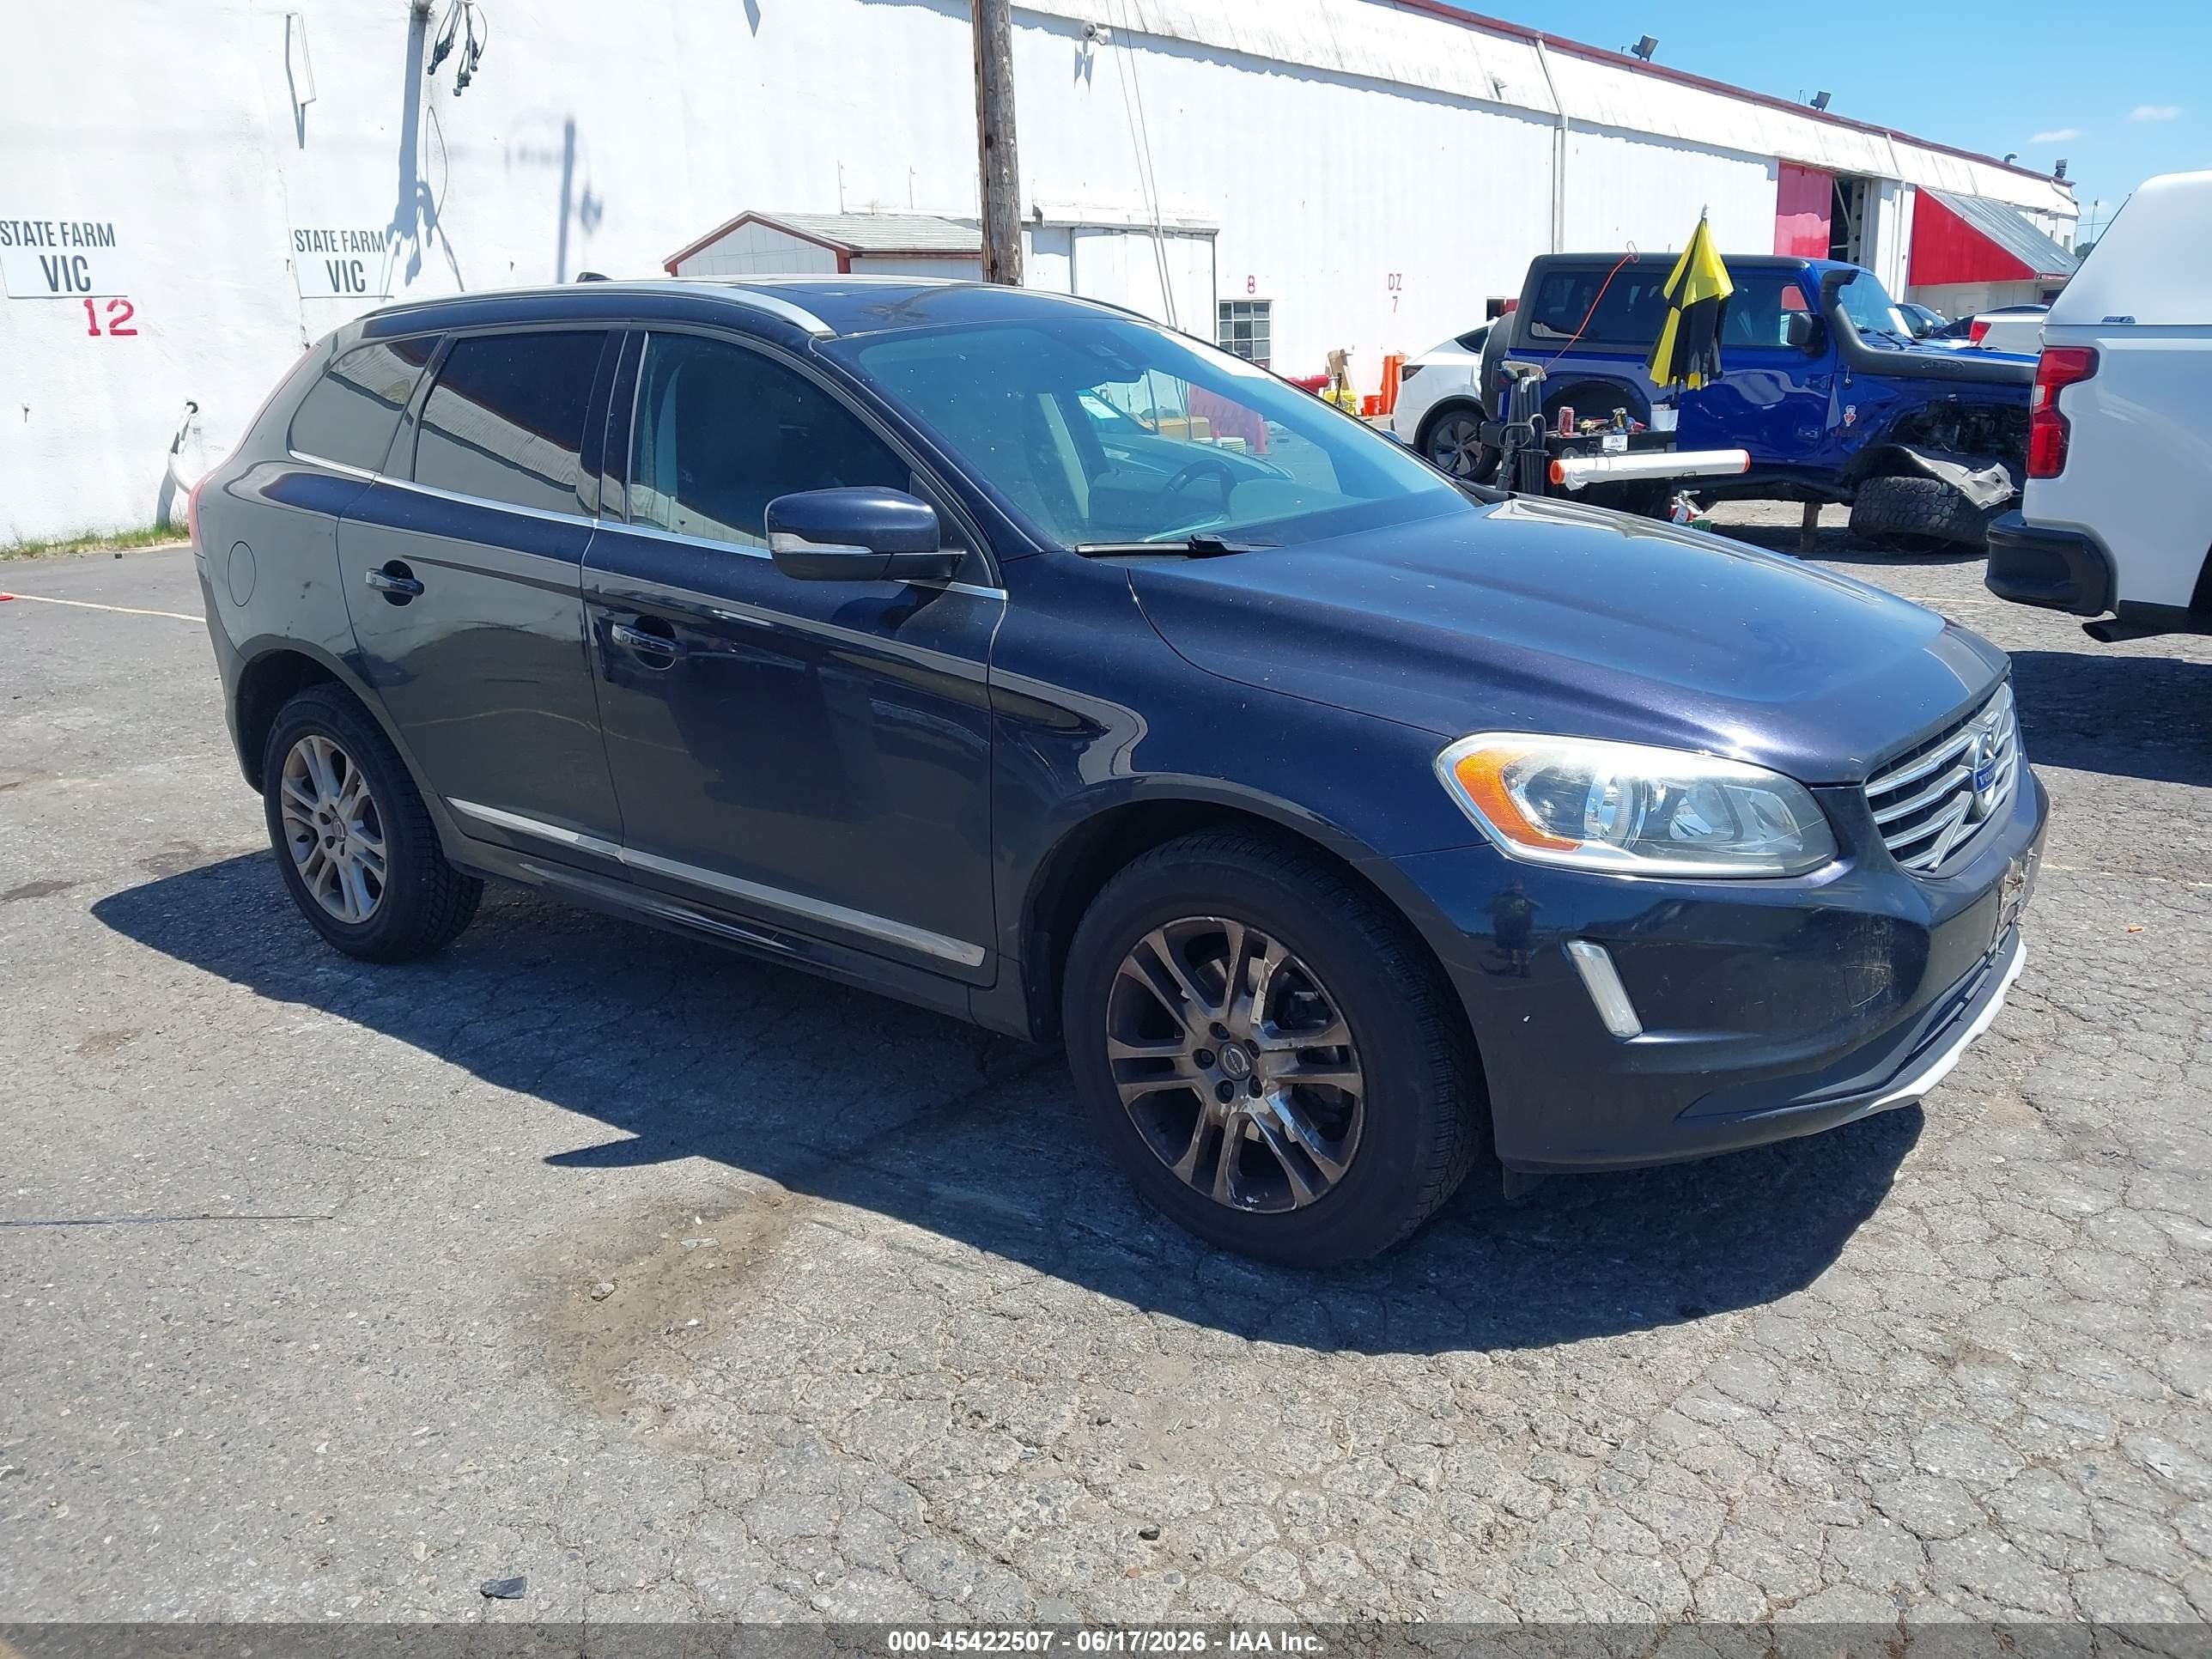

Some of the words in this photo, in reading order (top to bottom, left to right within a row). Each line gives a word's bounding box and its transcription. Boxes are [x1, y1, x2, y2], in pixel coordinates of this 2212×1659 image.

[0, 221, 57, 246] STATE
[60, 222, 116, 247] FARM
[295, 229, 338, 252] STATE
[341, 230, 386, 252] FARM
[40, 254, 91, 292] VIC
[325, 259, 366, 293] VIC
[1248, 275, 1255, 294] 8
[83, 299, 137, 336] 12
[1978, 769, 1995, 786] VOL
